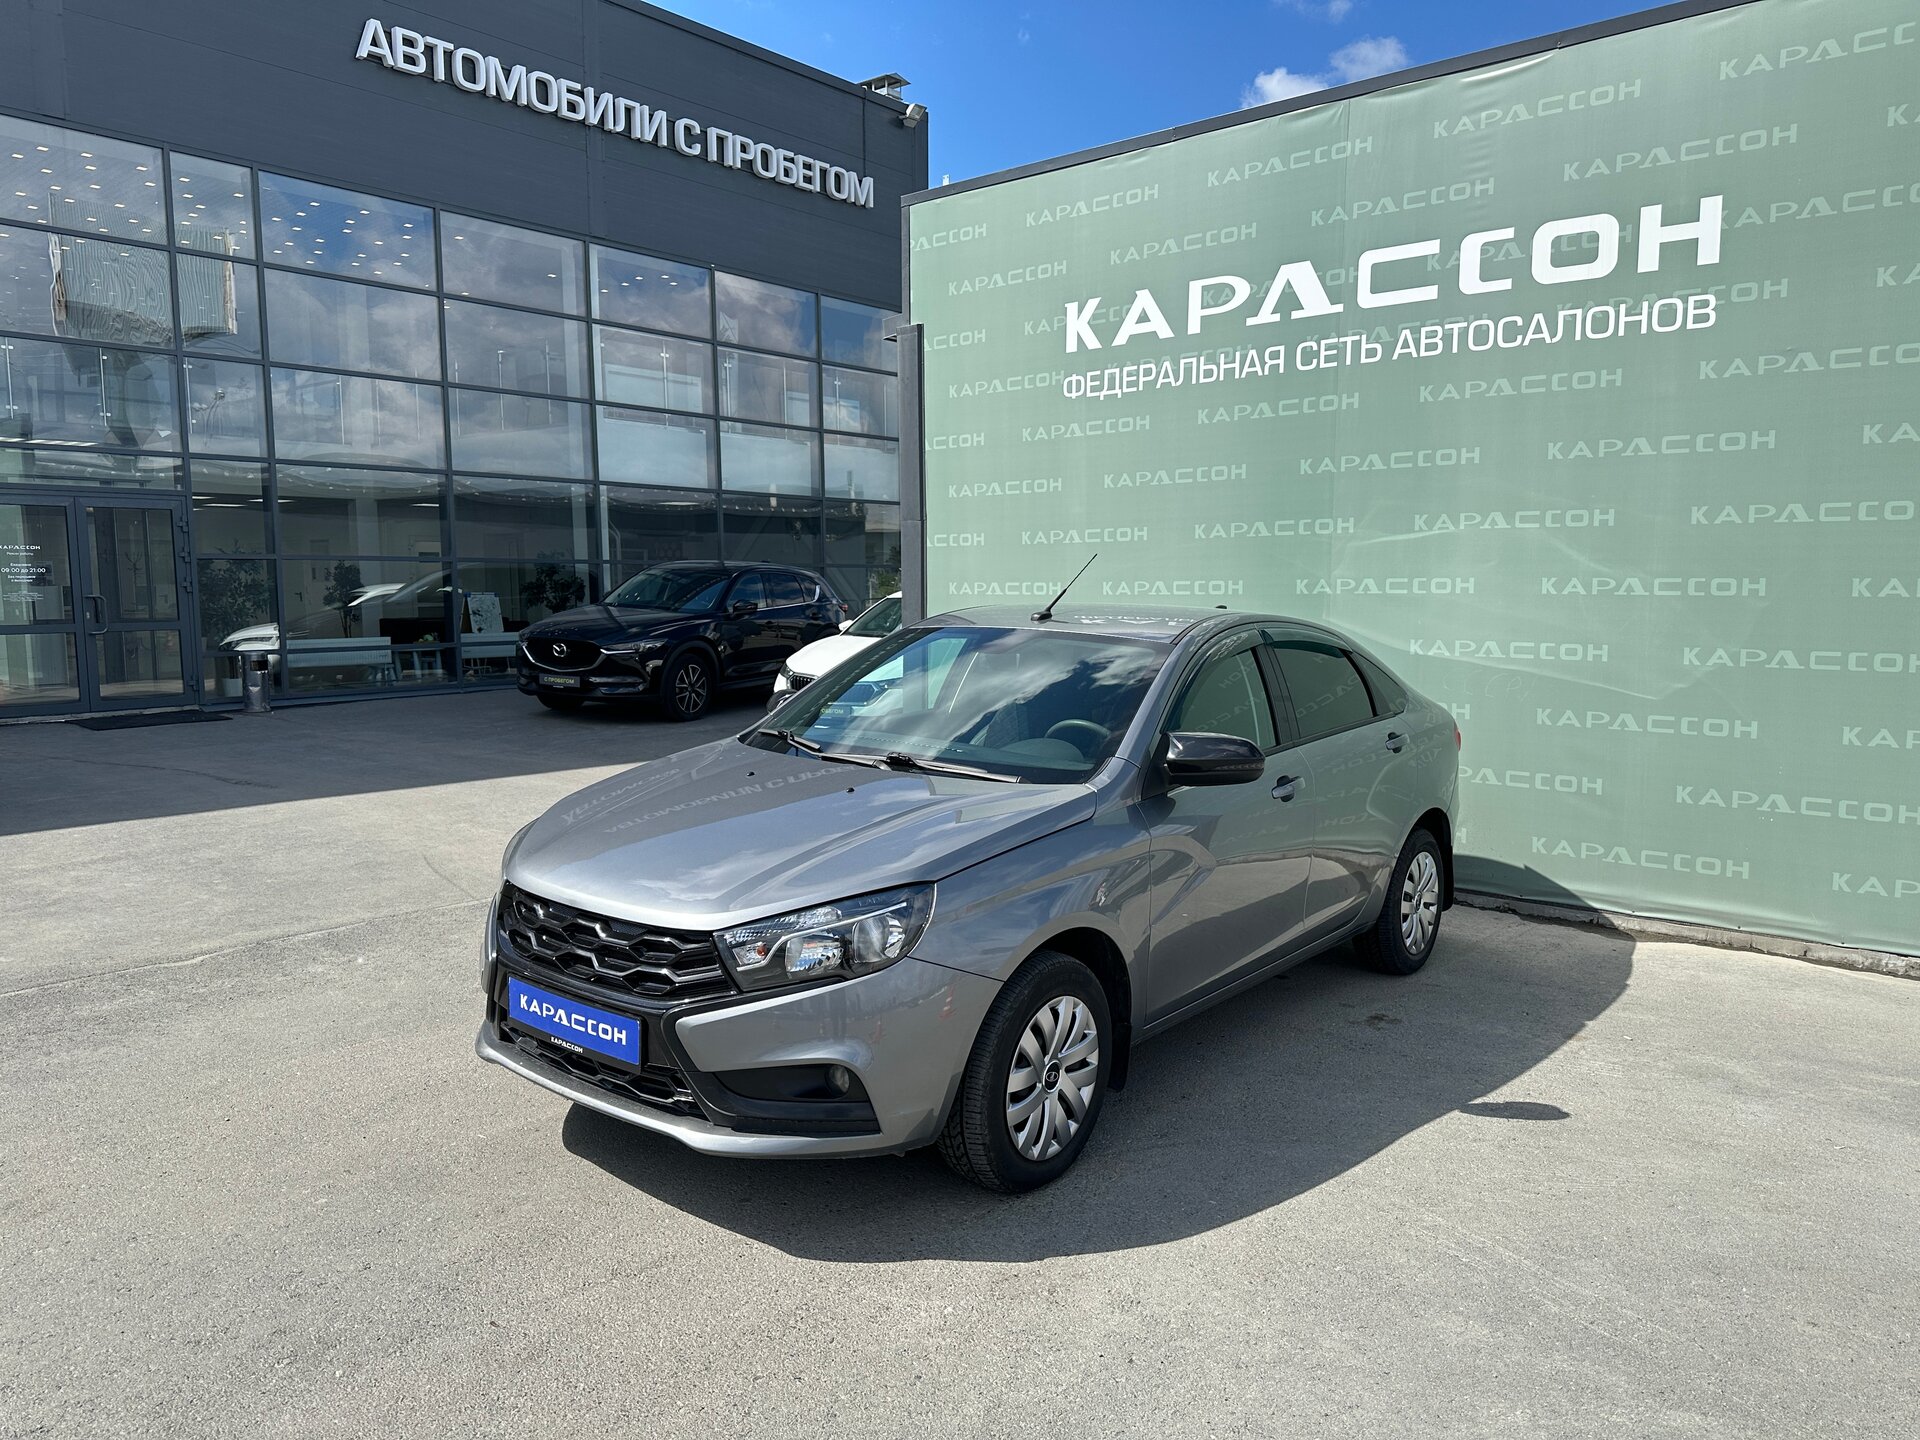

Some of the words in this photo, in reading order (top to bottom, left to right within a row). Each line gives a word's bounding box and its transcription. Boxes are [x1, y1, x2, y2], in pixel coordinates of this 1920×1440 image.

[355, 18, 668, 148] АВТОМОБИЛИ
[674, 117, 701, 157] С
[706, 126, 875, 208] ПРОБЕГОМ
[1433, 78, 1642, 139] КАРАССОН
[1207, 136, 1373, 188] КАРАССОН
[1563, 124, 1798, 182] КАРАССОН
[1026, 184, 1159, 227] КАРАССОН
[1311, 177, 1495, 228] КАРАССОН
[1110, 222, 1257, 266] КАРАССОН
[948, 260, 1067, 296] КАРАССОН
[1064, 194, 1724, 354] КАРАССОН
[1062, 345, 1285, 400] ФЕДЕРАЛЬНАЯ
[1295, 334, 1383, 371] СЕТЬ
[1391, 293, 1717, 361] АВТОСАЛОНОВ
[1419, 368, 1623, 403] КАРАССОН
[1197, 392, 1360, 425] КАРАССОН
[1022, 415, 1150, 443] КАРАССОН
[1547, 430, 1776, 461] КАРАССОН
[1103, 463, 1247, 489] КАРАССОН
[1300, 446, 1480, 475] КАРАССОН
[948, 478, 1062, 498] КАРАССОН
[1022, 526, 1148, 545] КАРАССОН
[1194, 517, 1354, 539] КАРАССОН
[1414, 508, 1615, 532] КАРАССОН
[1102, 580, 1243, 596] КАРАССОН
[1296, 577, 1475, 596] КАРАССОН
[1541, 577, 1766, 597] КАРАССОН
[1409, 639, 1609, 662] КАРАССОН
[1536, 707, 1758, 739] КАРАССОН
[1531, 836, 1749, 879] КАРАССОН
[519, 992, 627, 1046] КАРАССОН
